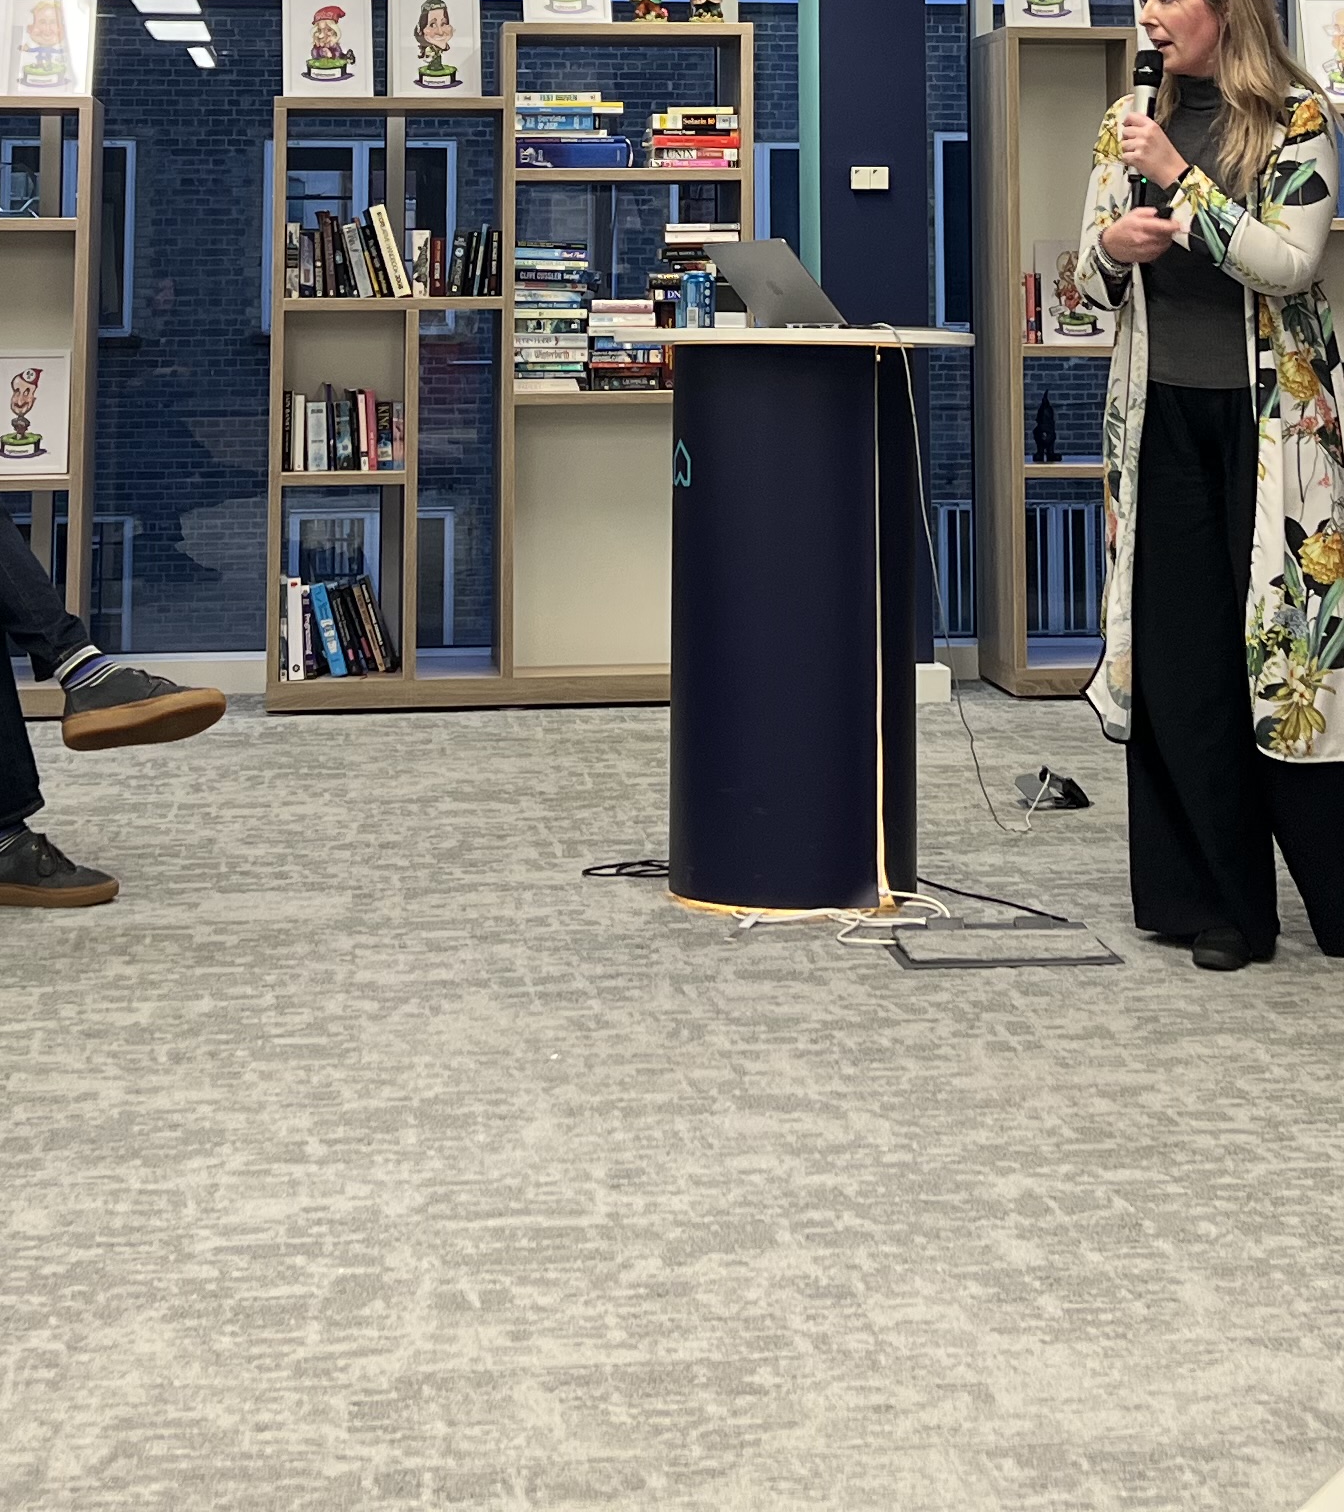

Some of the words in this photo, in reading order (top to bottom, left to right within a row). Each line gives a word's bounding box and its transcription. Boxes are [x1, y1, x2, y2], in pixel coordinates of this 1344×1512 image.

[682, 117, 707, 125] Solaris
[664, 148, 696, 160] UNIX
[667, 290, 681, 299] DN
[377, 405, 390, 430] KING
